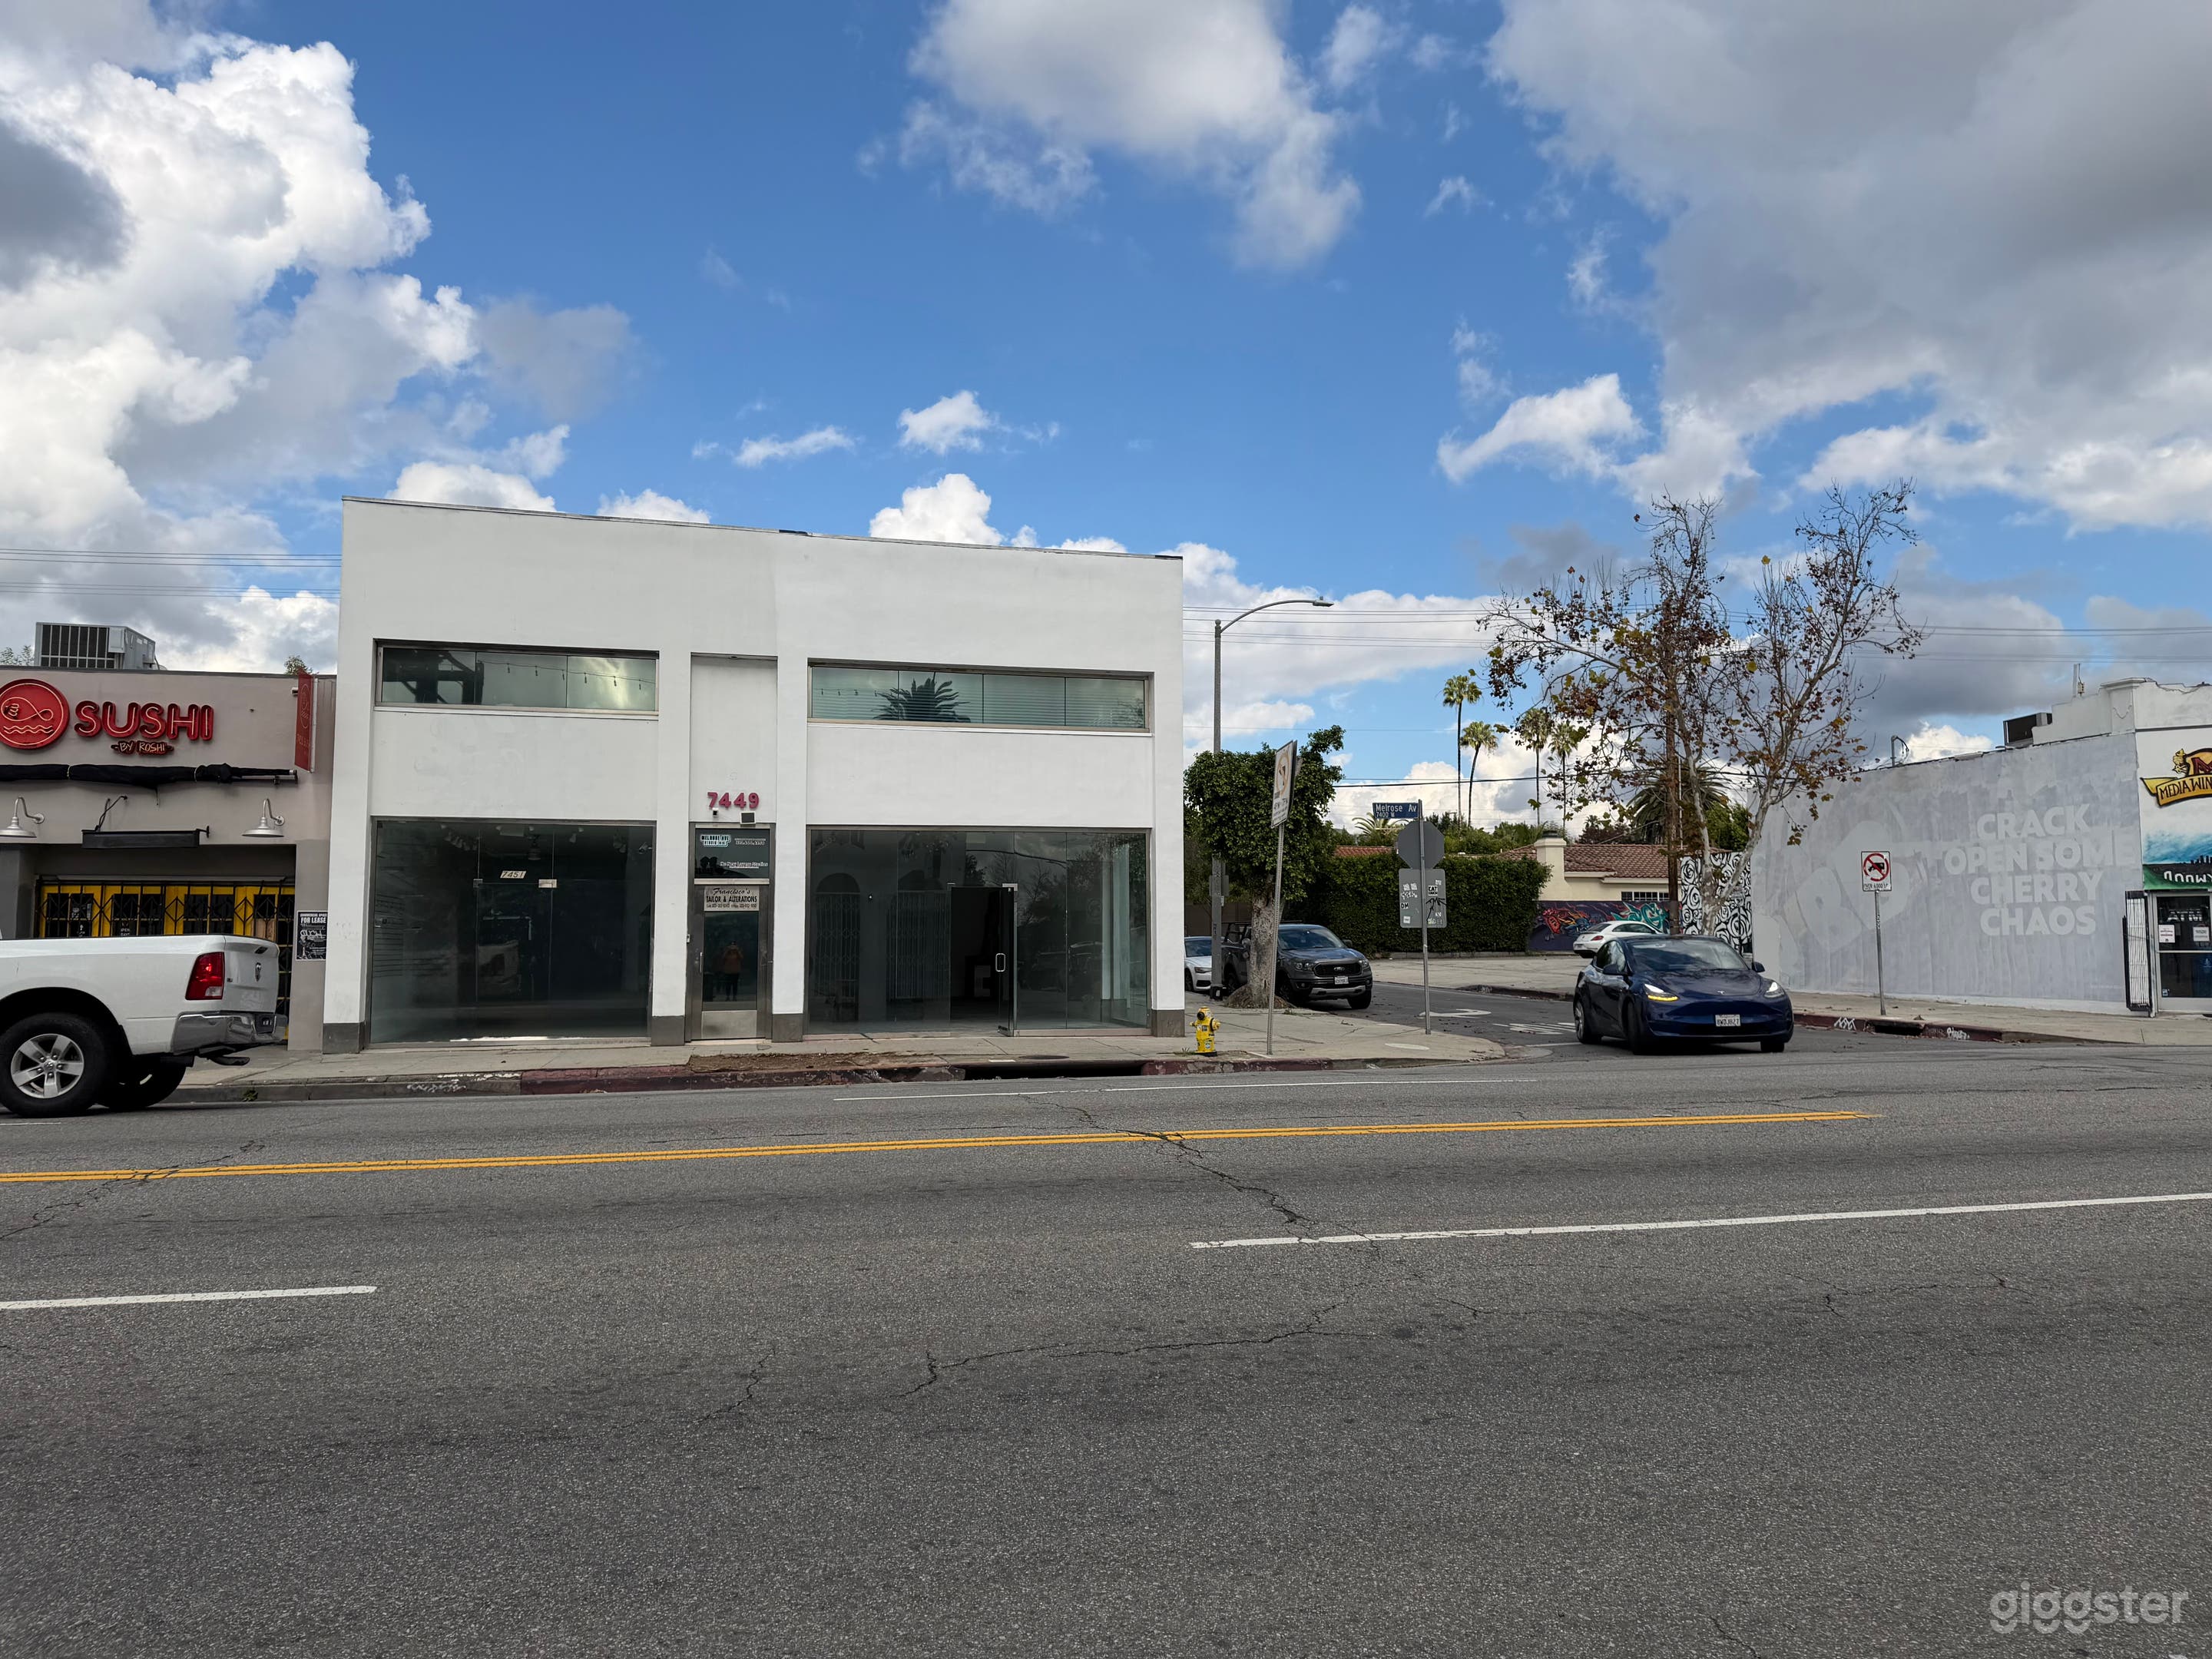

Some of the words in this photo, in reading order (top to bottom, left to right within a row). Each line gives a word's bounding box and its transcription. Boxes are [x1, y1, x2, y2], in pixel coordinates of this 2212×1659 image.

[75, 700, 214, 740] SUSHI
[119, 742, 133, 752] BY
[139, 743, 165, 752] ROSHI
[707, 792, 760, 810] 7449
[2159, 780, 2192, 800] MEDIA
[1376, 803, 1403, 813] Melrose
[1408, 803, 1417, 813] Av
[1977, 804, 2090, 840] CRACK
[1944, 842, 2028, 876] OPEN
[2035, 828, 2136, 870] SOME
[1971, 870, 2103, 905] CHERRY
[1981, 906, 2096, 935] CHAOS
